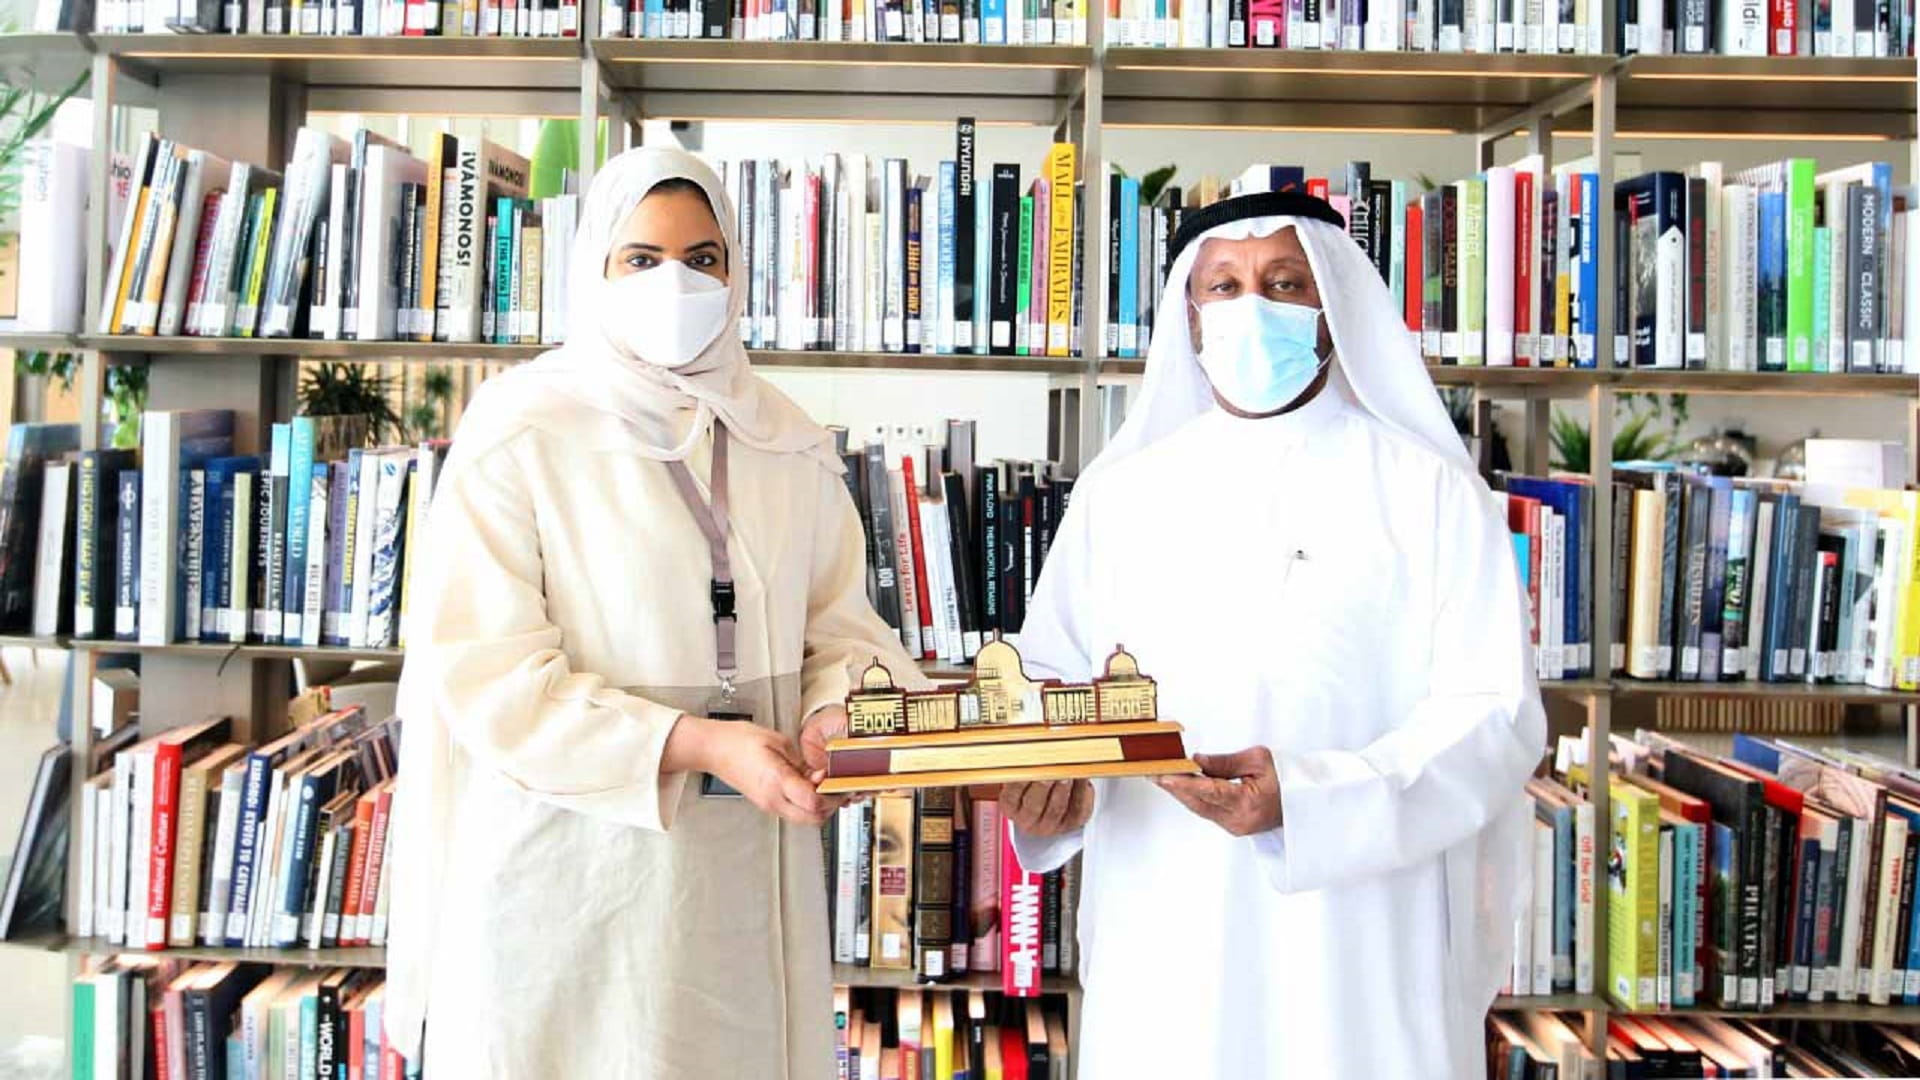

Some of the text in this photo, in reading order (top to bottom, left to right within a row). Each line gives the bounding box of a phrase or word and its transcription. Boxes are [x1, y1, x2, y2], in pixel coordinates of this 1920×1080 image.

[959, 136, 971, 196] HYUNDAI
[1053, 152, 1072, 204] MALL
[457, 151, 479, 267] ¡VÁMONOS!
[1052, 227, 1071, 321] EMIRATES
[1860, 194, 1874, 330] MODERN CLASSIC
[82, 474, 94, 530] HISTORY
[258, 470, 271, 567] EPIC JOURNEYS
[291, 505, 304, 558] WORLD
[187, 480, 203, 592] ADVENTURE
[271, 532, 282, 594] BEAUTIFUL
[896, 532, 909, 556] Life
[878, 567, 894, 587] 100
[239, 848, 252, 863] TO
[241, 810, 259, 848] KYOTO
[150, 812, 169, 913] Traditional Couture
[1581, 835, 1592, 904] Off the Grid
[1743, 885, 1759, 967] PIRATES
[318, 1022, 333, 1075] WORLD
